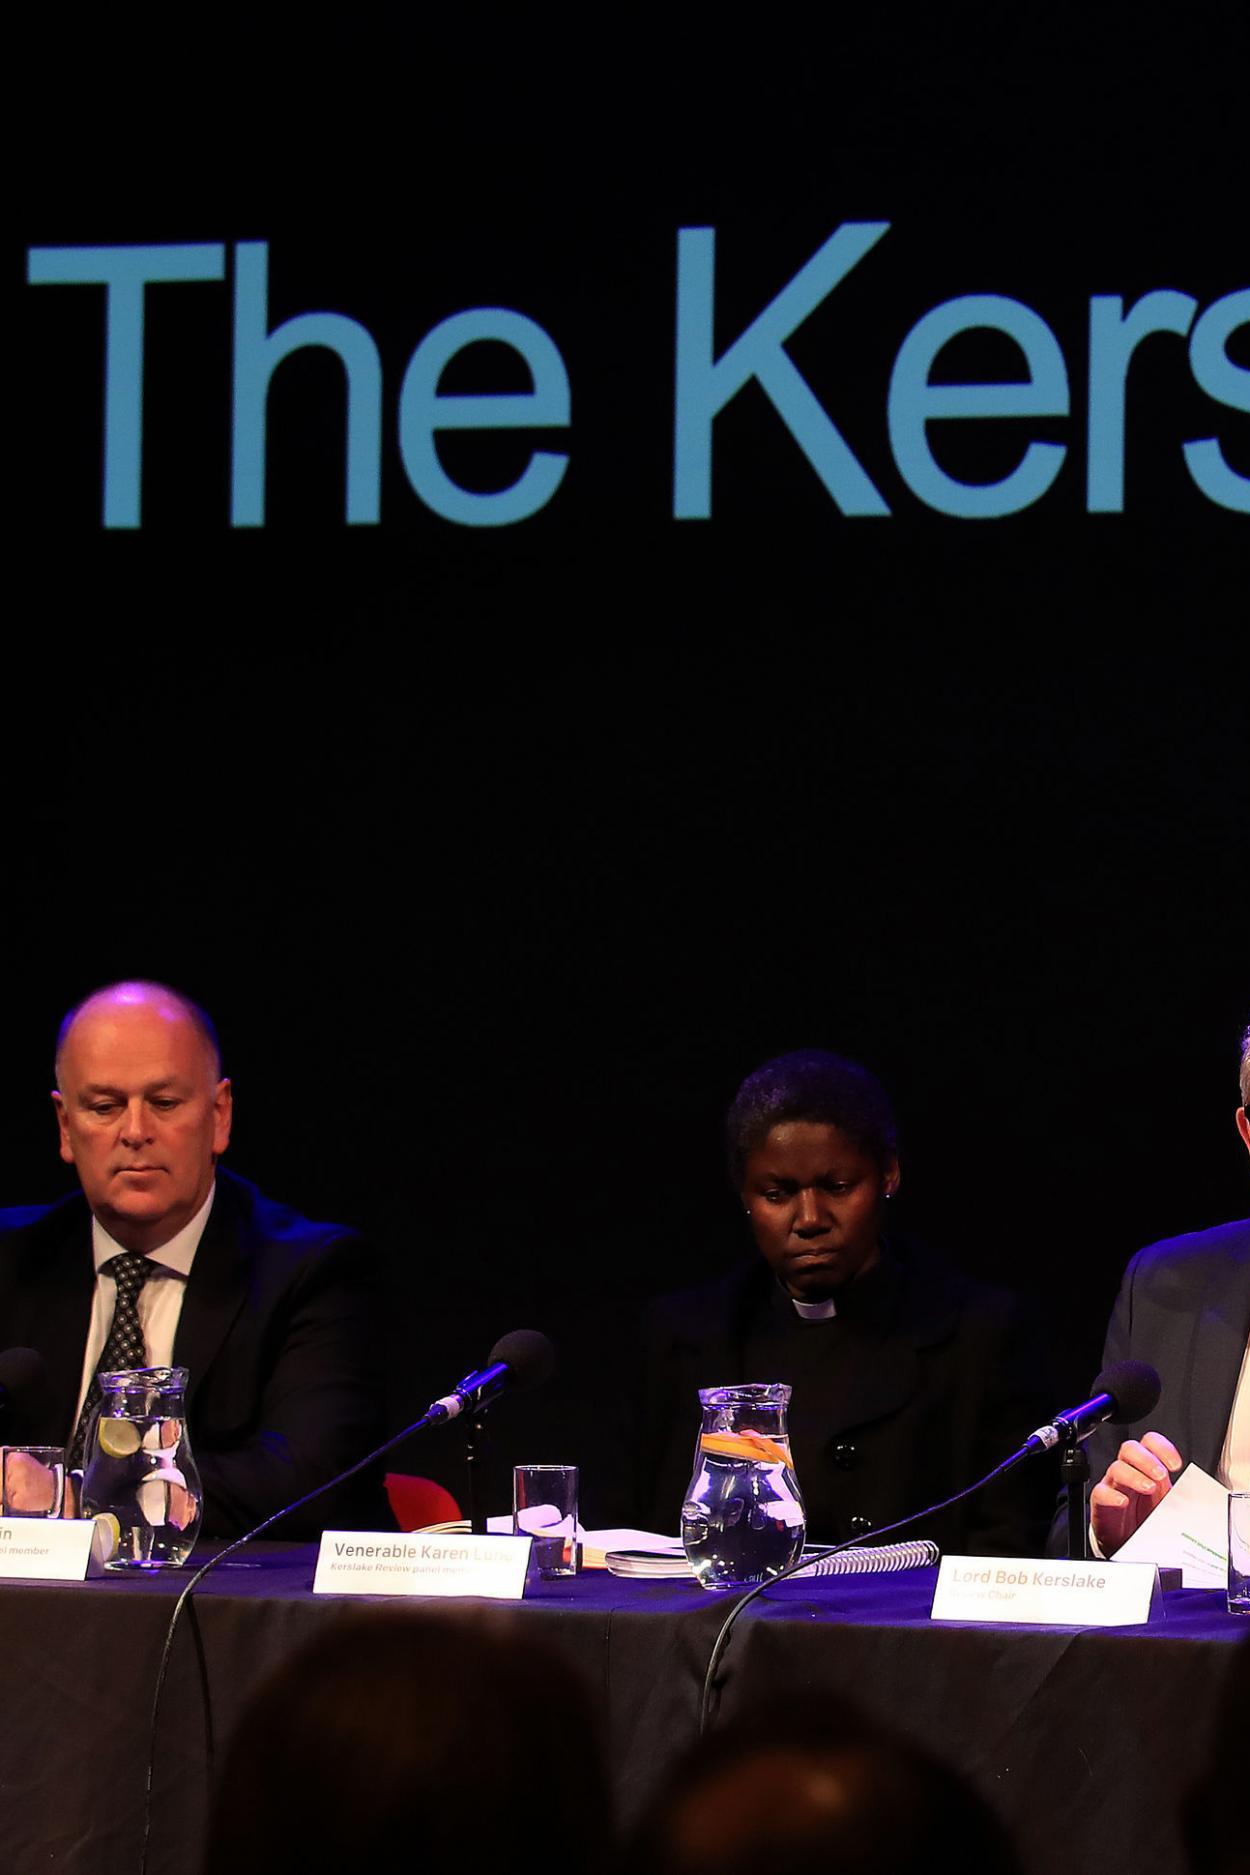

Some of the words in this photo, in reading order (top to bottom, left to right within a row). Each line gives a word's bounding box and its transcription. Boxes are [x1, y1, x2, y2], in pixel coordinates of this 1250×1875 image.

[27, 240, 571, 528] The
[334, 1542, 416, 1559] Venerable
[420, 1545, 469, 1560] Karen
[330, 1562, 373, 1573] Kerslake
[952, 1568, 991, 1584] Lord
[995, 1570, 1028, 1585] Bob
[1033, 1571, 1106, 1589] Kerslake
[988, 1589, 1016, 1600] Chair
